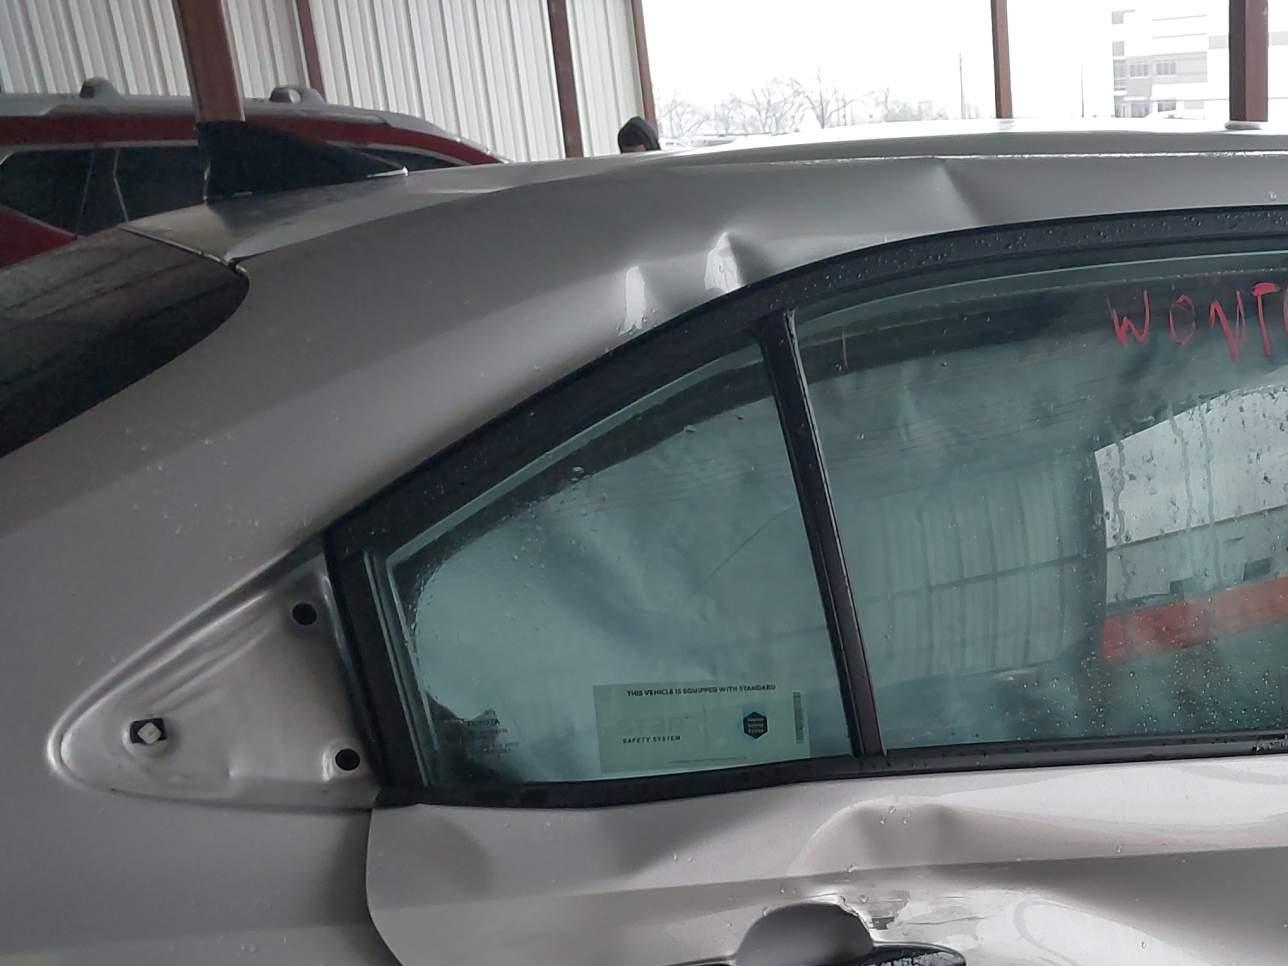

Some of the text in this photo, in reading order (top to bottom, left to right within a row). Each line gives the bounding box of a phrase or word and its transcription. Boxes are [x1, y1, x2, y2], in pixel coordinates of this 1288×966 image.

[626, 684, 776, 697] THIS VEHICLE IS EQUIPPED WITH STANDARD
[622, 735, 681, 744] SAFETY SYSTEM
